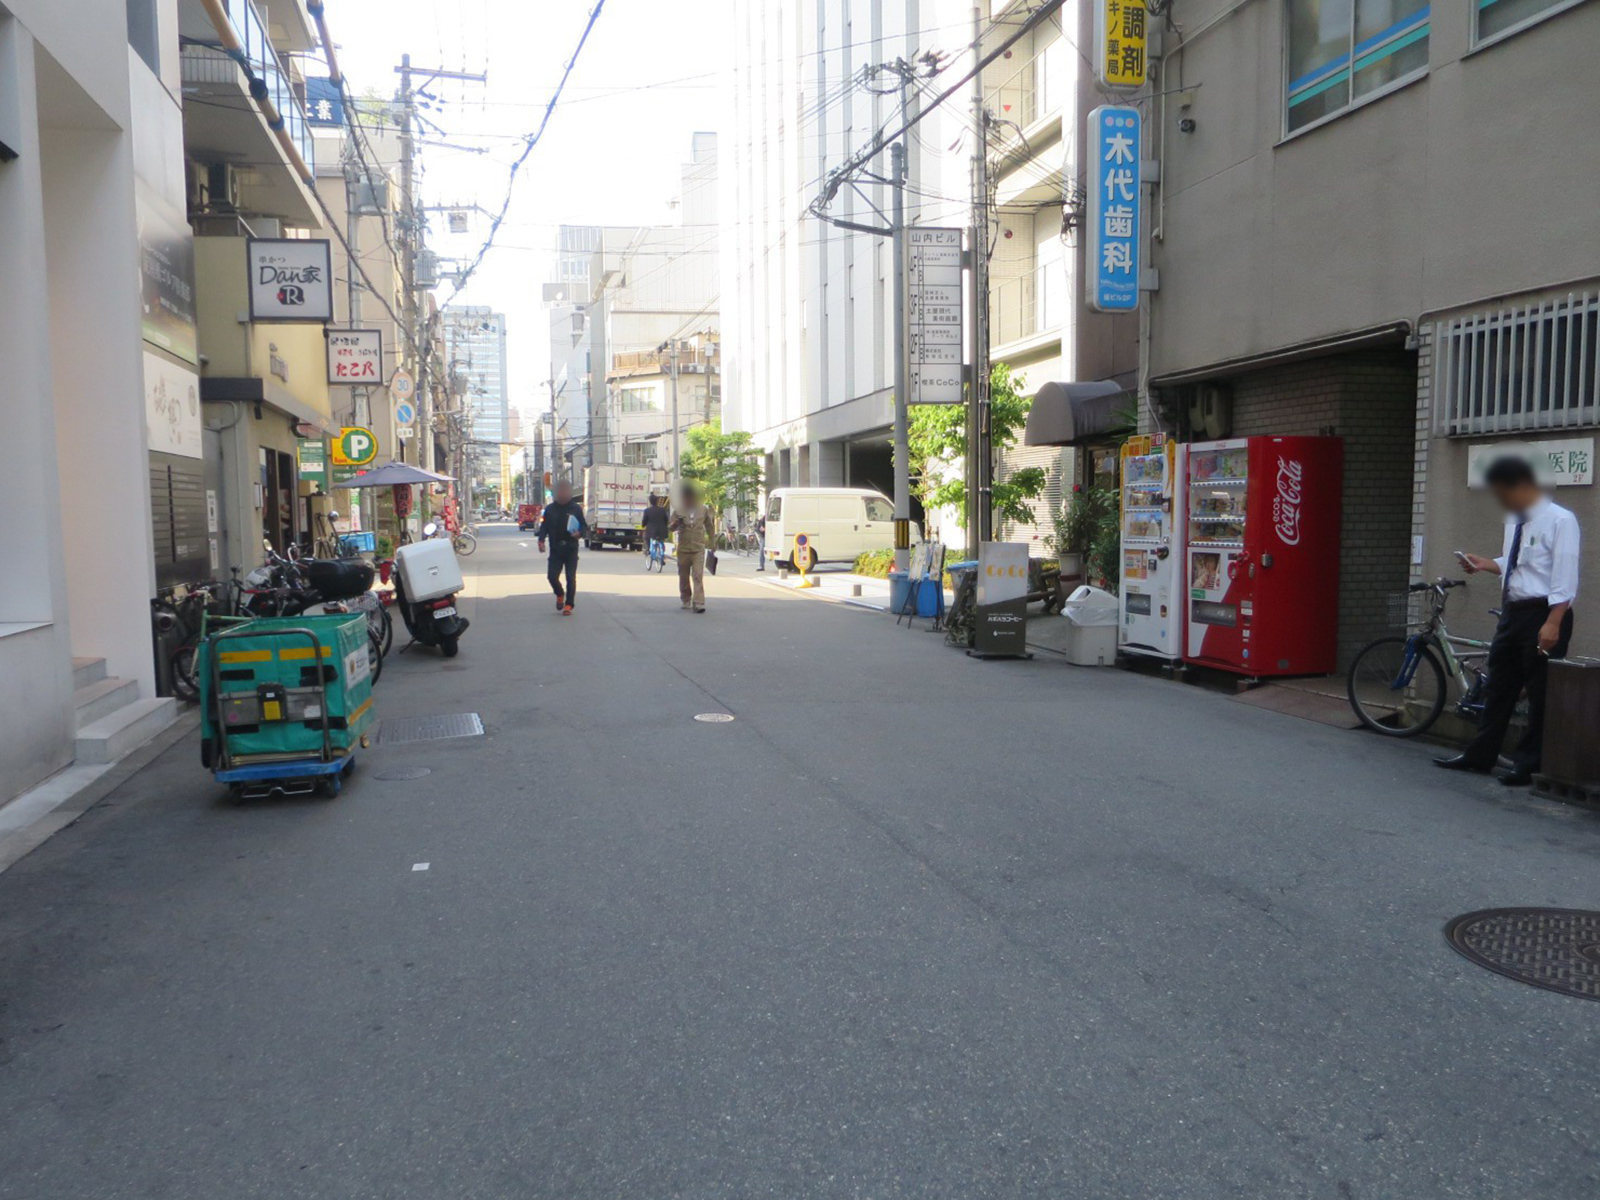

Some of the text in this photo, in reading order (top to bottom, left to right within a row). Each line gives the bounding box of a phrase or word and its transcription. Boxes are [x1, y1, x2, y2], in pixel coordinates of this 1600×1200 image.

[1103, 132, 1135, 275] 木代歯科
[911, 232, 956, 243] 山内ビル
[397, 379, 409, 391] 30
[936, 378, 960, 386] CoCo
[351, 435, 370, 458] P
[1572, 474, 1584, 483] 2F
[603, 482, 644, 491] TONAMI
